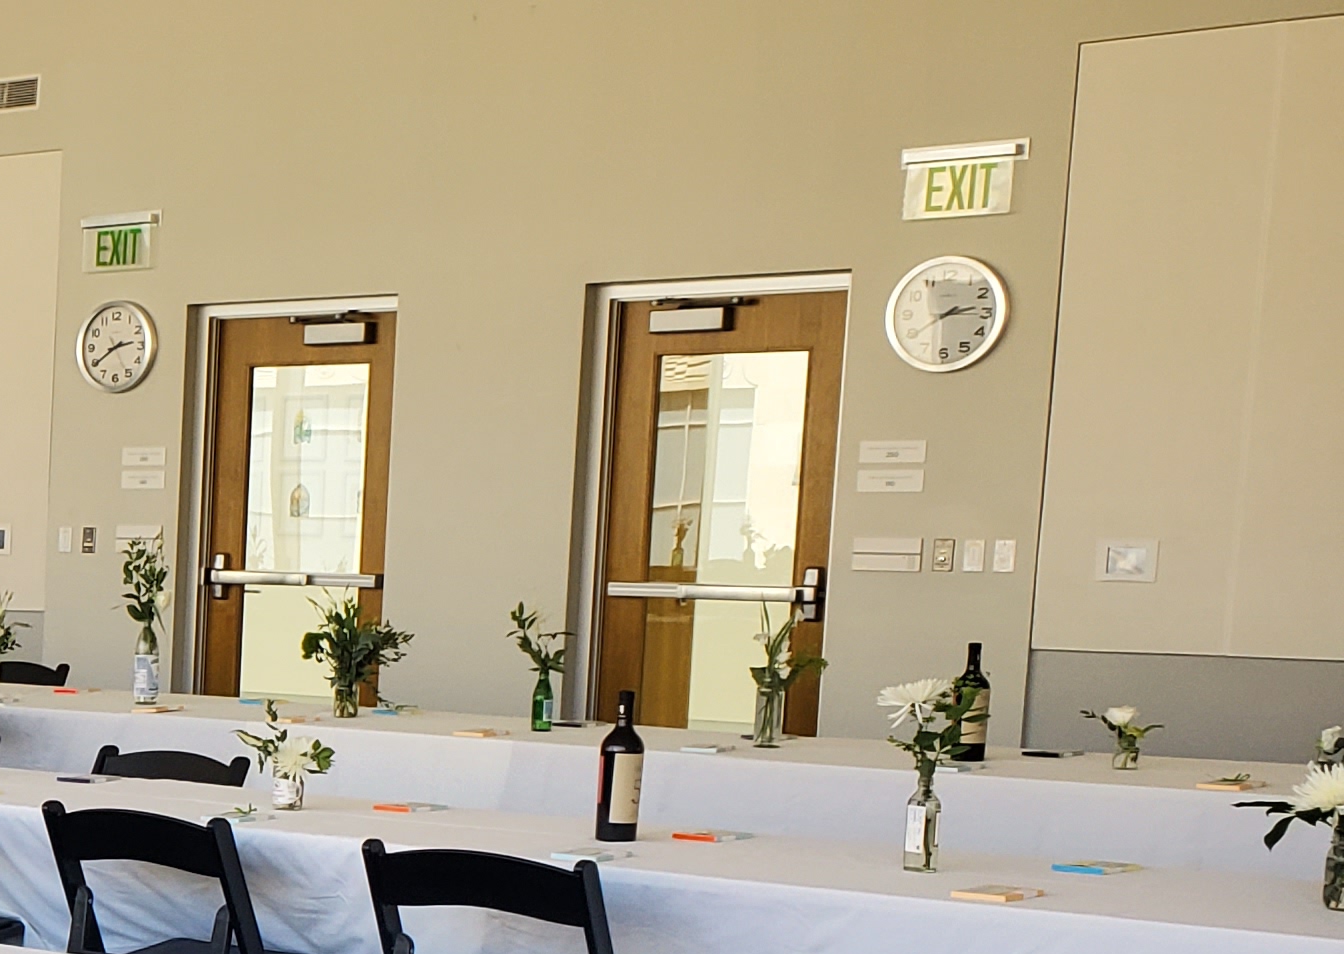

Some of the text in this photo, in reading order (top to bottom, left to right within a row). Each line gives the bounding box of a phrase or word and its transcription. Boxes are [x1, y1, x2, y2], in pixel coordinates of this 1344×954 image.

[925, 162, 998, 212] EXIT
[96, 229, 142, 267] EXIT
[977, 288, 989, 299] 2
[112, 311, 122, 321] 12
[979, 307, 993, 319] 3
[92, 328, 100, 338] 10
[134, 326, 142, 335] 2
[974, 326, 986, 337] 4
[88, 344, 95, 353] 9
[137, 341, 144, 350] 3
[958, 342, 971, 353] 5
[939, 348, 949, 359] 6
[134, 356, 141, 364] 4
[100, 370, 107, 379] 7
[112, 374, 119, 383] 6
[124, 369, 132, 378] 5
